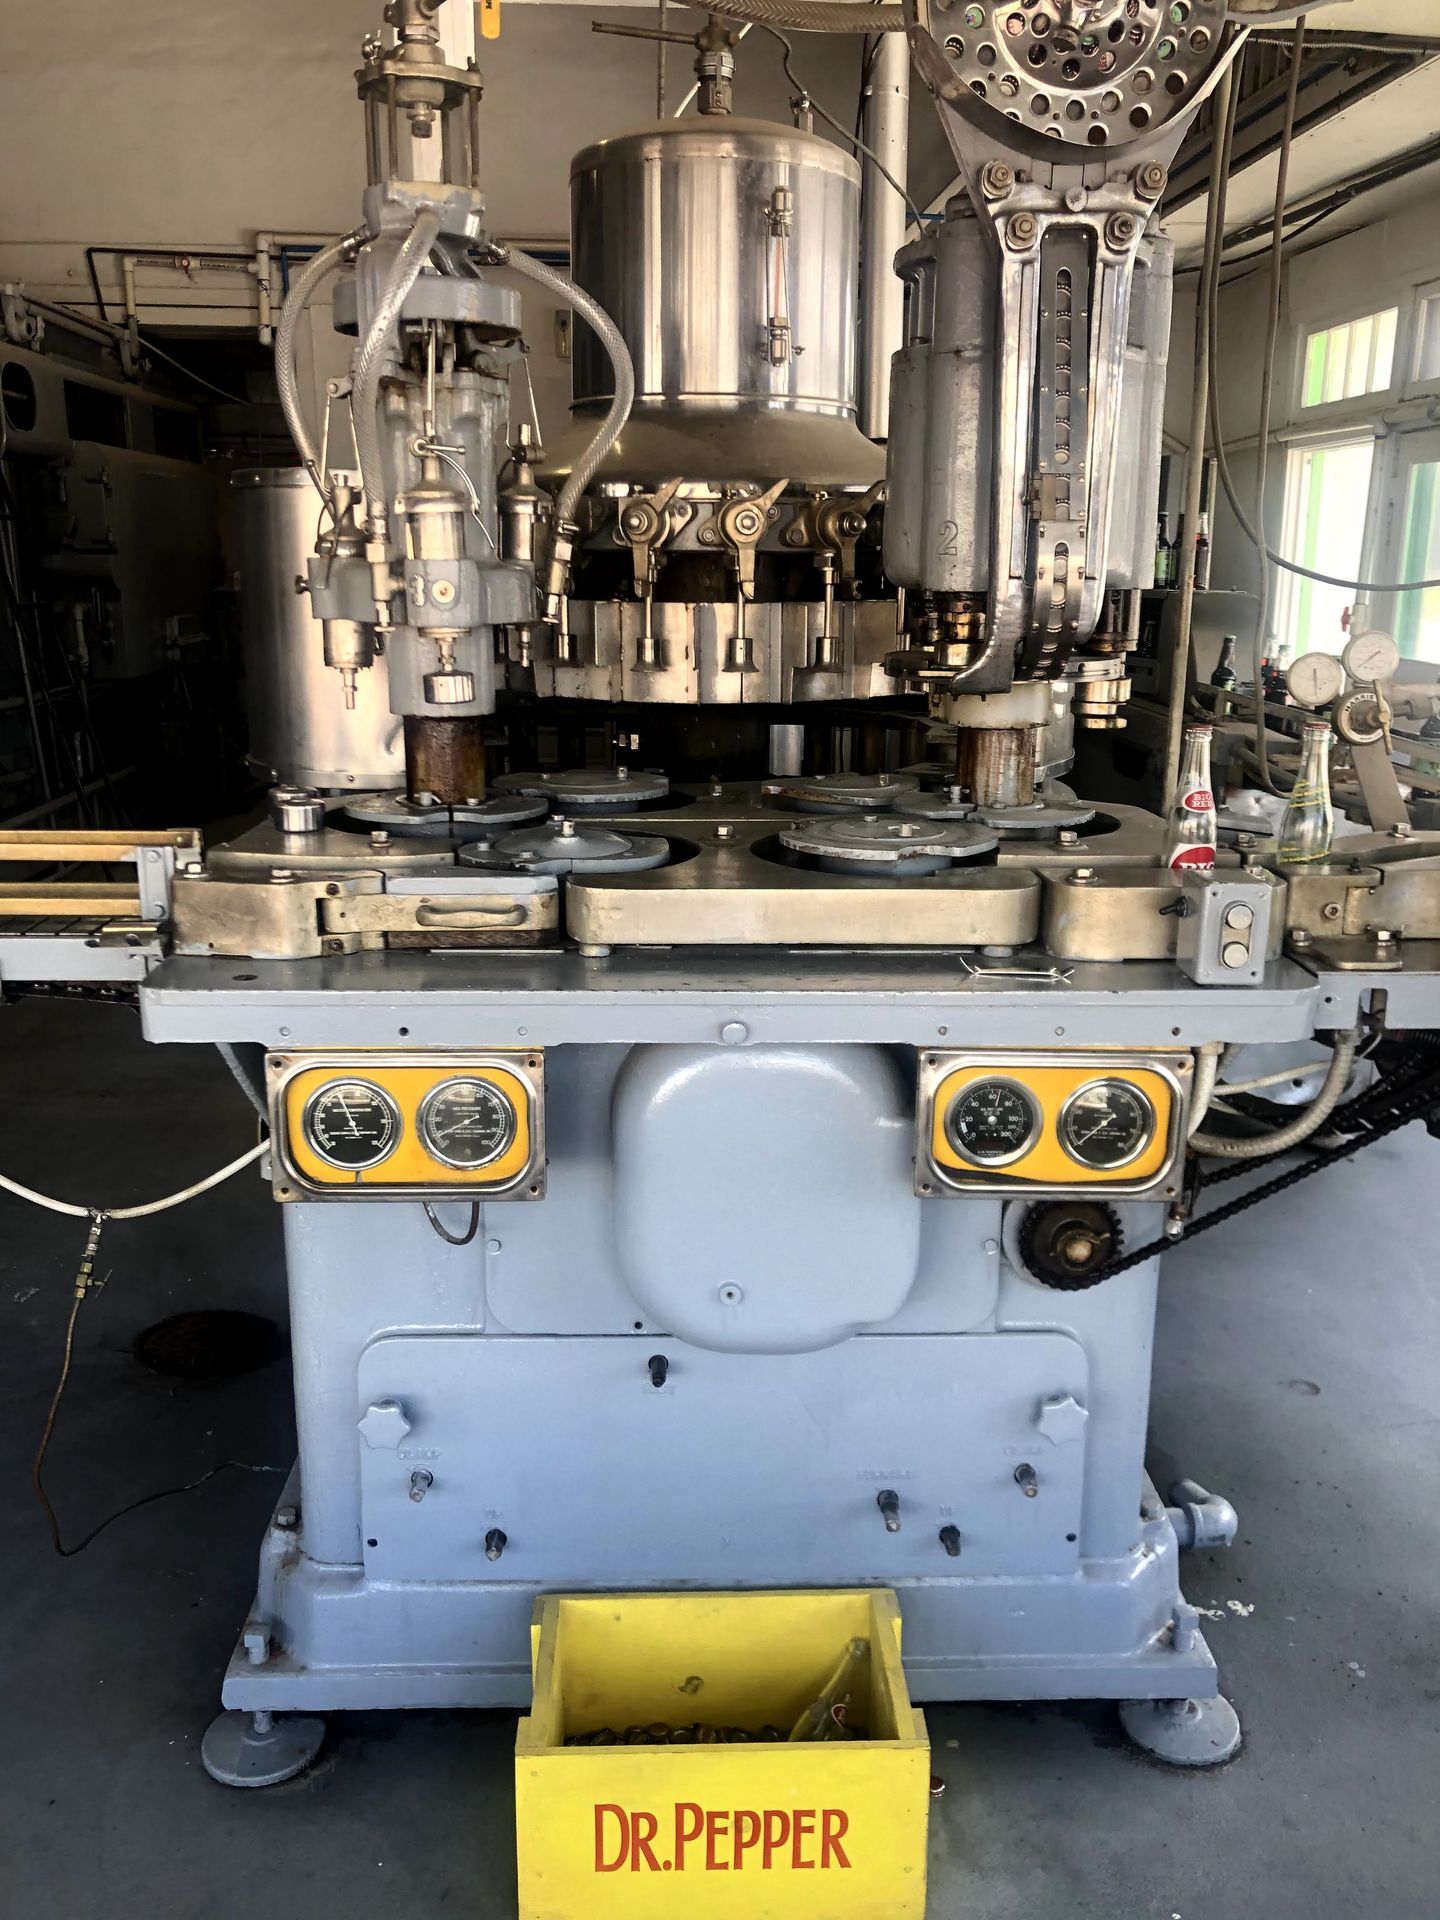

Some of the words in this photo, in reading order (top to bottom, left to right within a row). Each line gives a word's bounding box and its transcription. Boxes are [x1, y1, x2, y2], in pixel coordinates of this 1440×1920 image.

[936, 520, 959, 556] 2
[1345, 694, 1375, 712] HARRIS
[1192, 793, 1212, 801] BIG
[1192, 800, 1214, 808] RED
